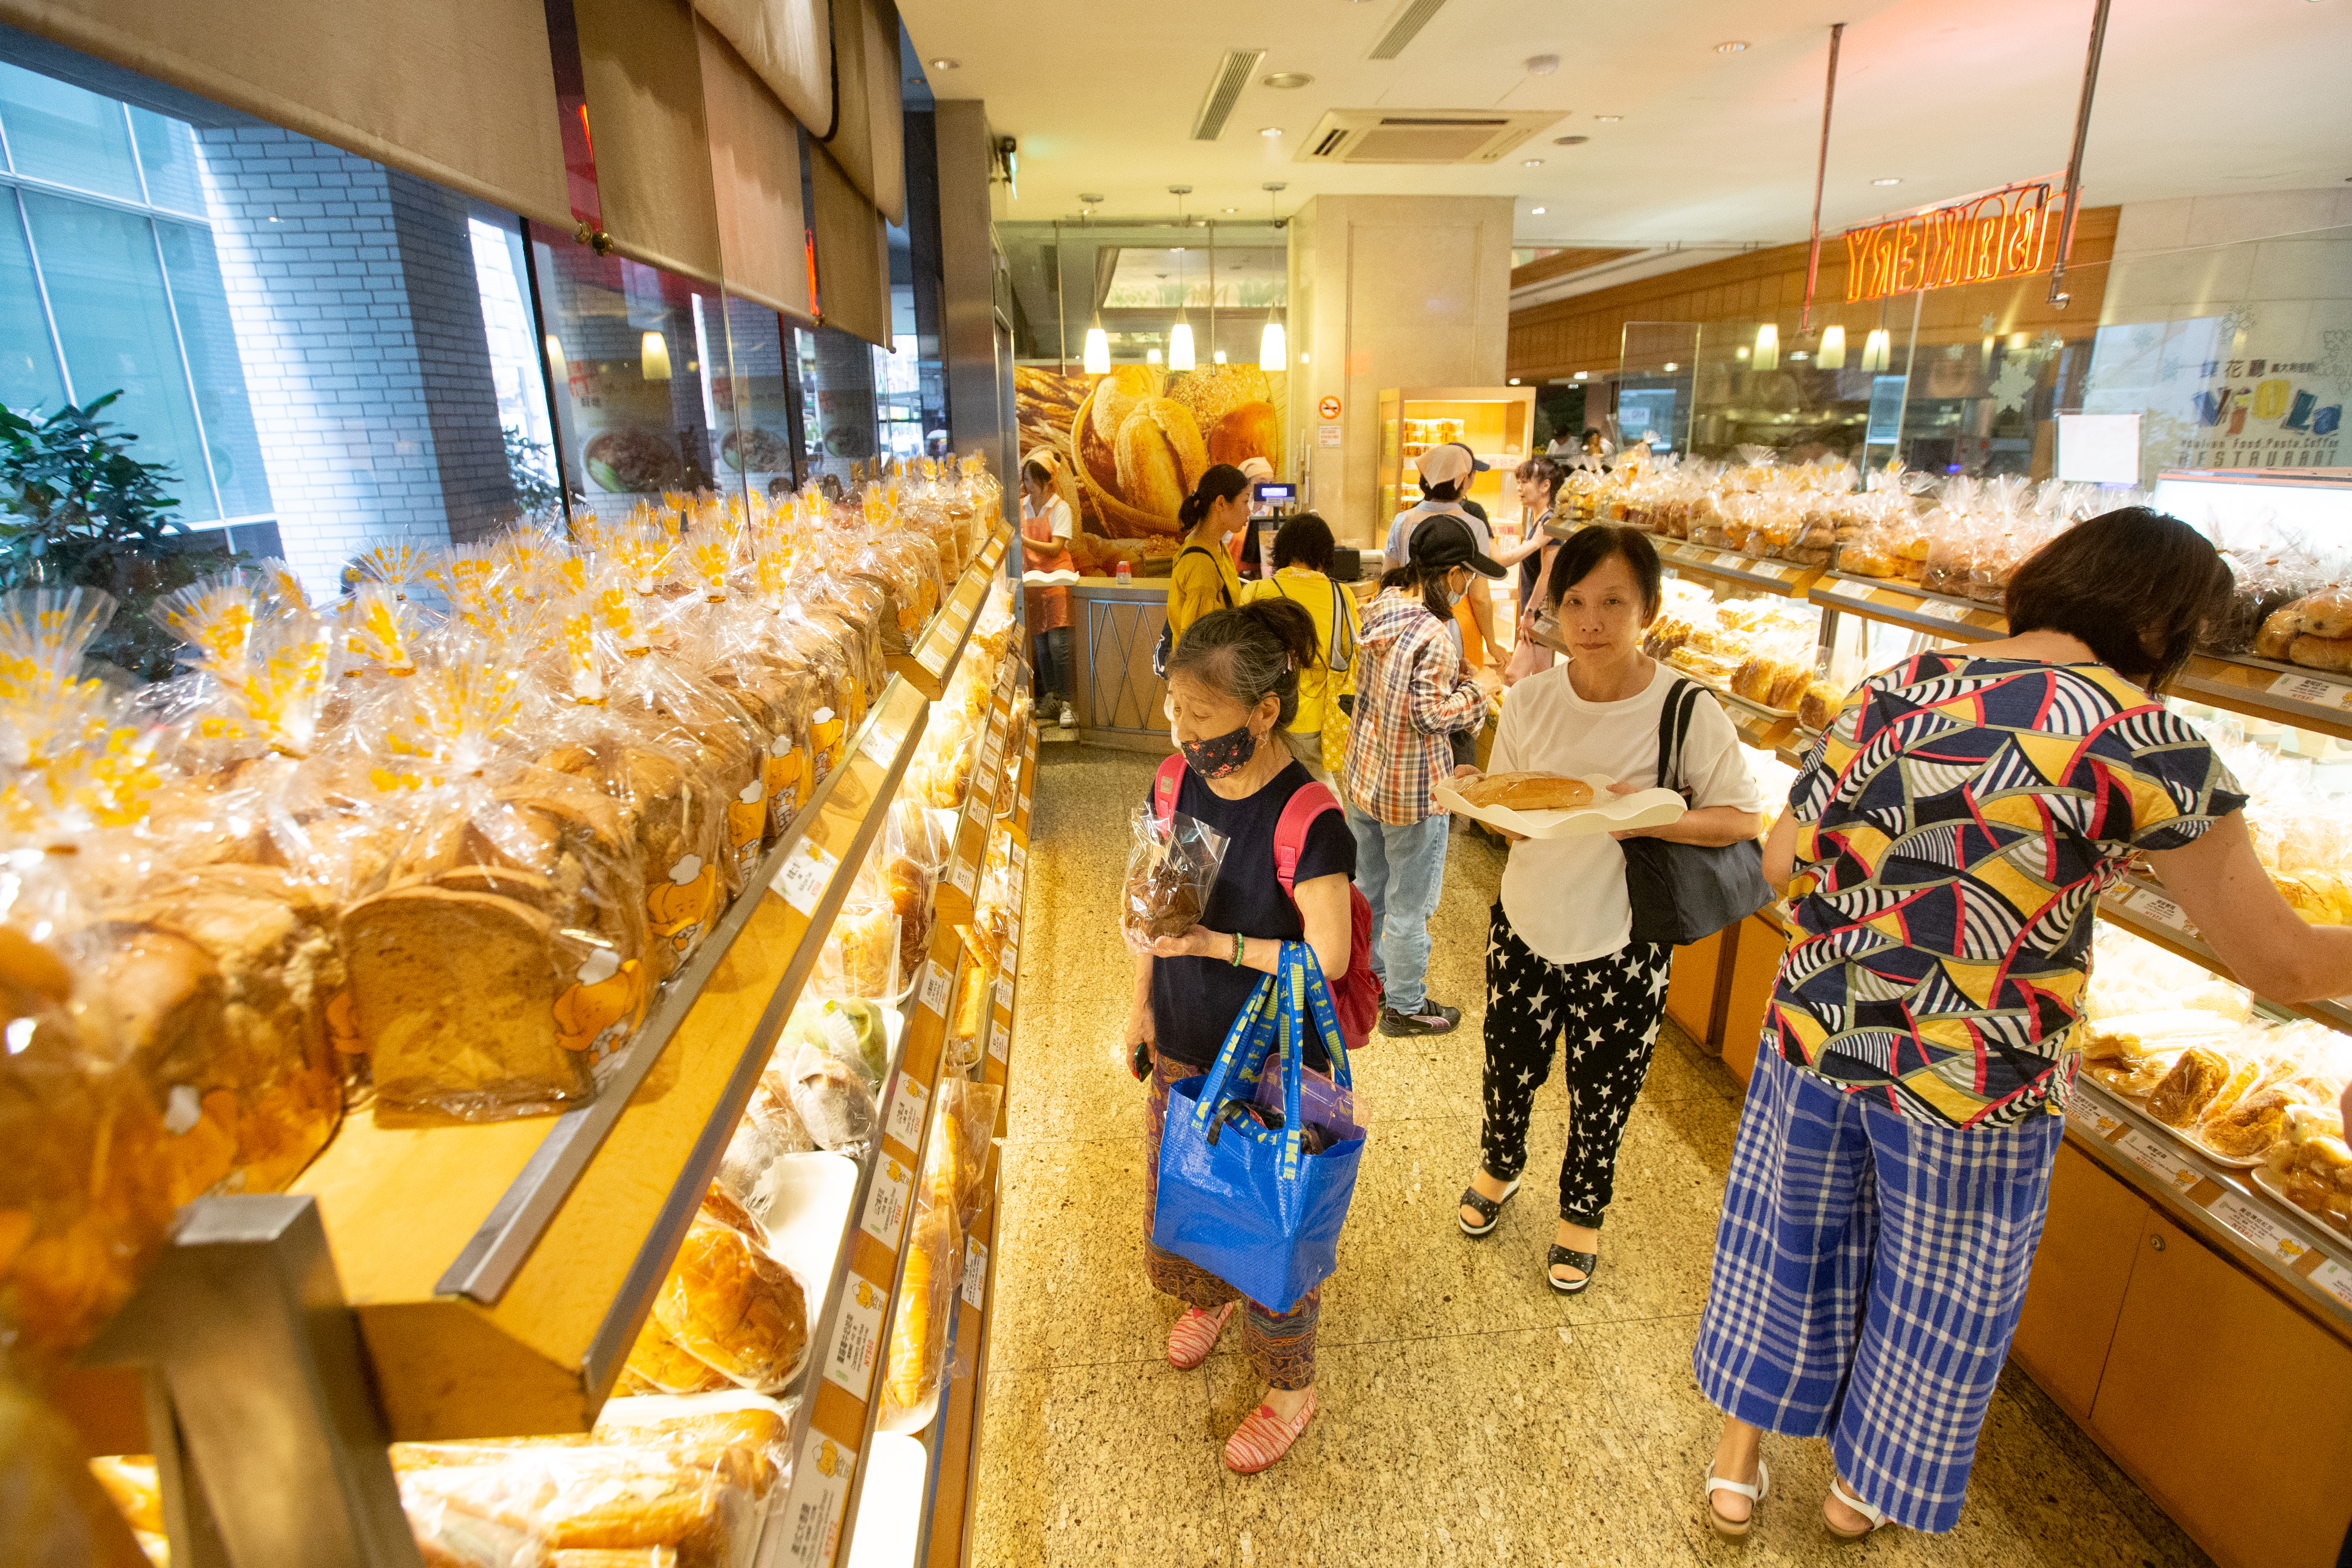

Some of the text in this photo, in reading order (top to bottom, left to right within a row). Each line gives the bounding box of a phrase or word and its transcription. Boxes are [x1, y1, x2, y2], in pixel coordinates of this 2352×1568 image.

[1249, 975, 1271, 1023] IKE
[1220, 994, 1259, 1064] IKEA
[1282, 1128, 1300, 1180] IKE
